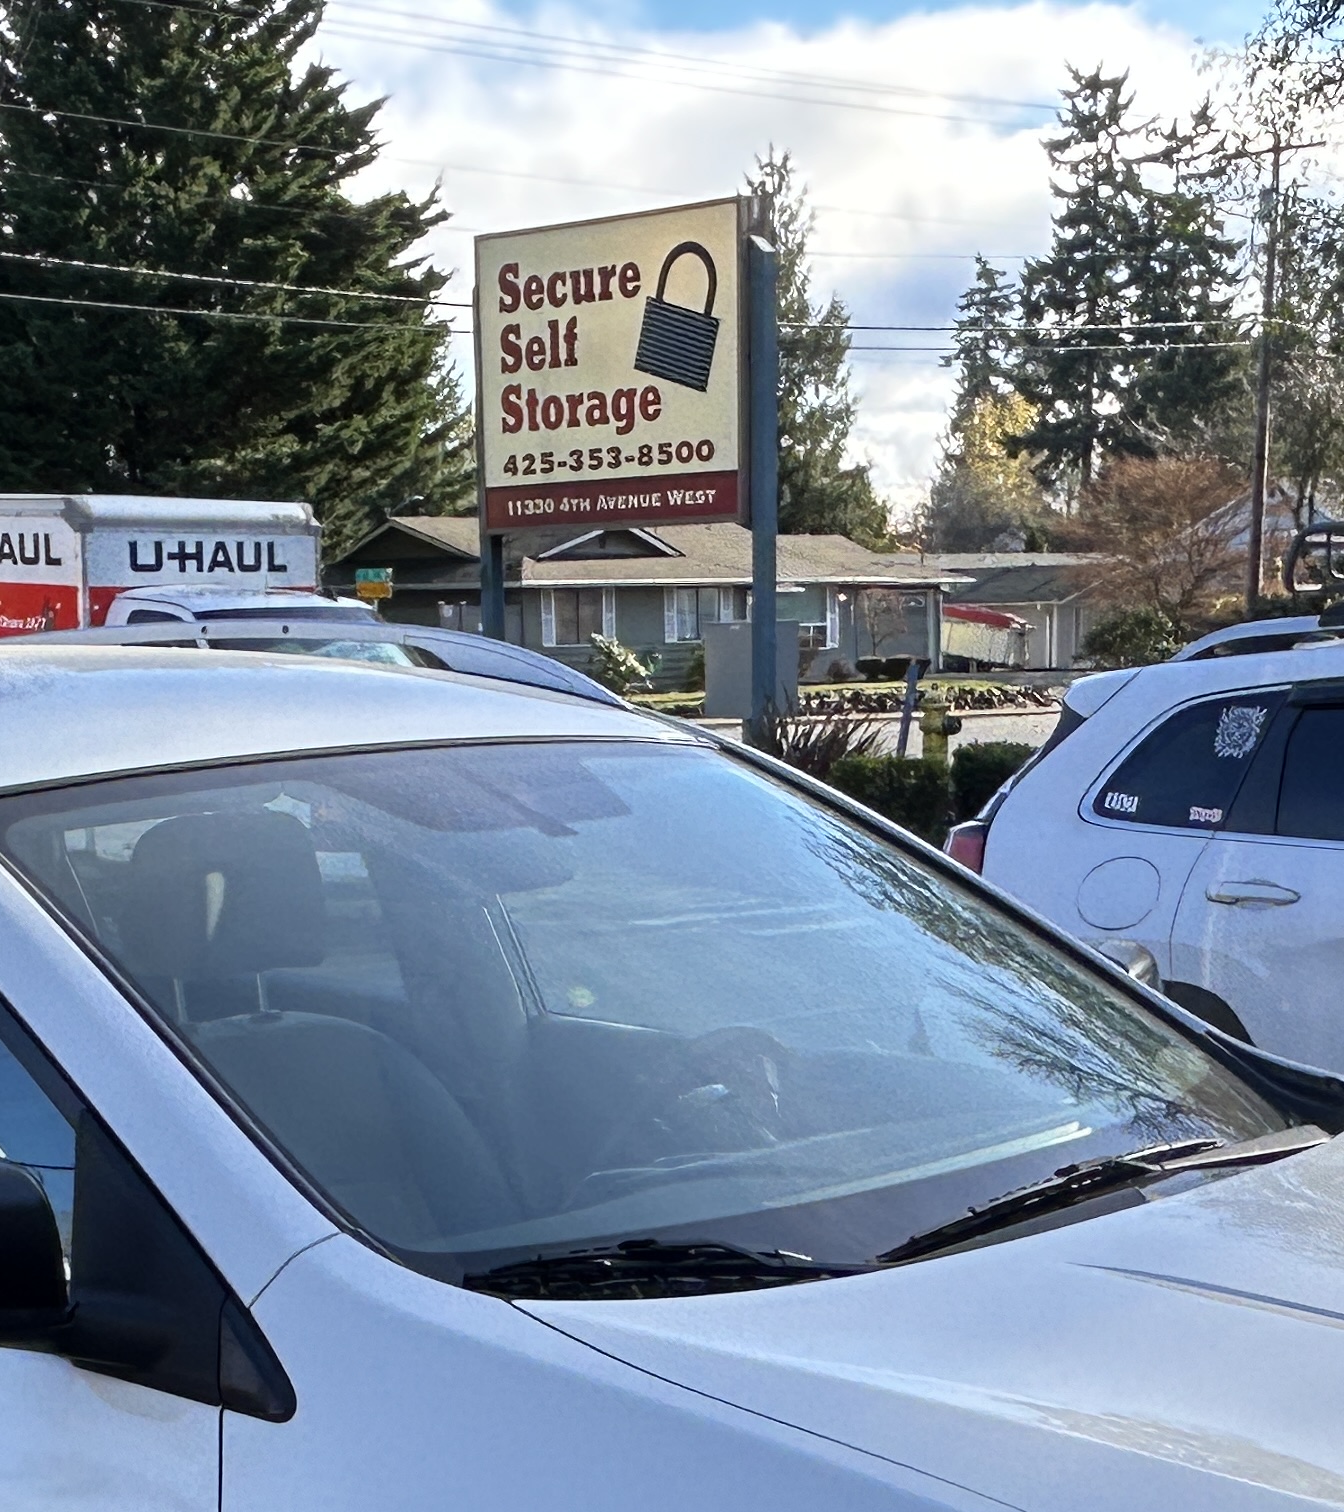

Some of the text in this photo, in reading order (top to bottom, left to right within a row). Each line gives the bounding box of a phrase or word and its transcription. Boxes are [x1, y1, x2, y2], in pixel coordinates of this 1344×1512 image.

[497, 260, 642, 314] Secure
[499, 315, 578, 375] Self
[501, 382, 662, 436] Storage
[503, 438, 715, 477] 425-353-8500
[559, 496, 591, 512] 4TH
[596, 492, 662, 511] AVENUE
[666, 488, 717, 506] WEST
[128, 539, 288, 574] U-HAUL
